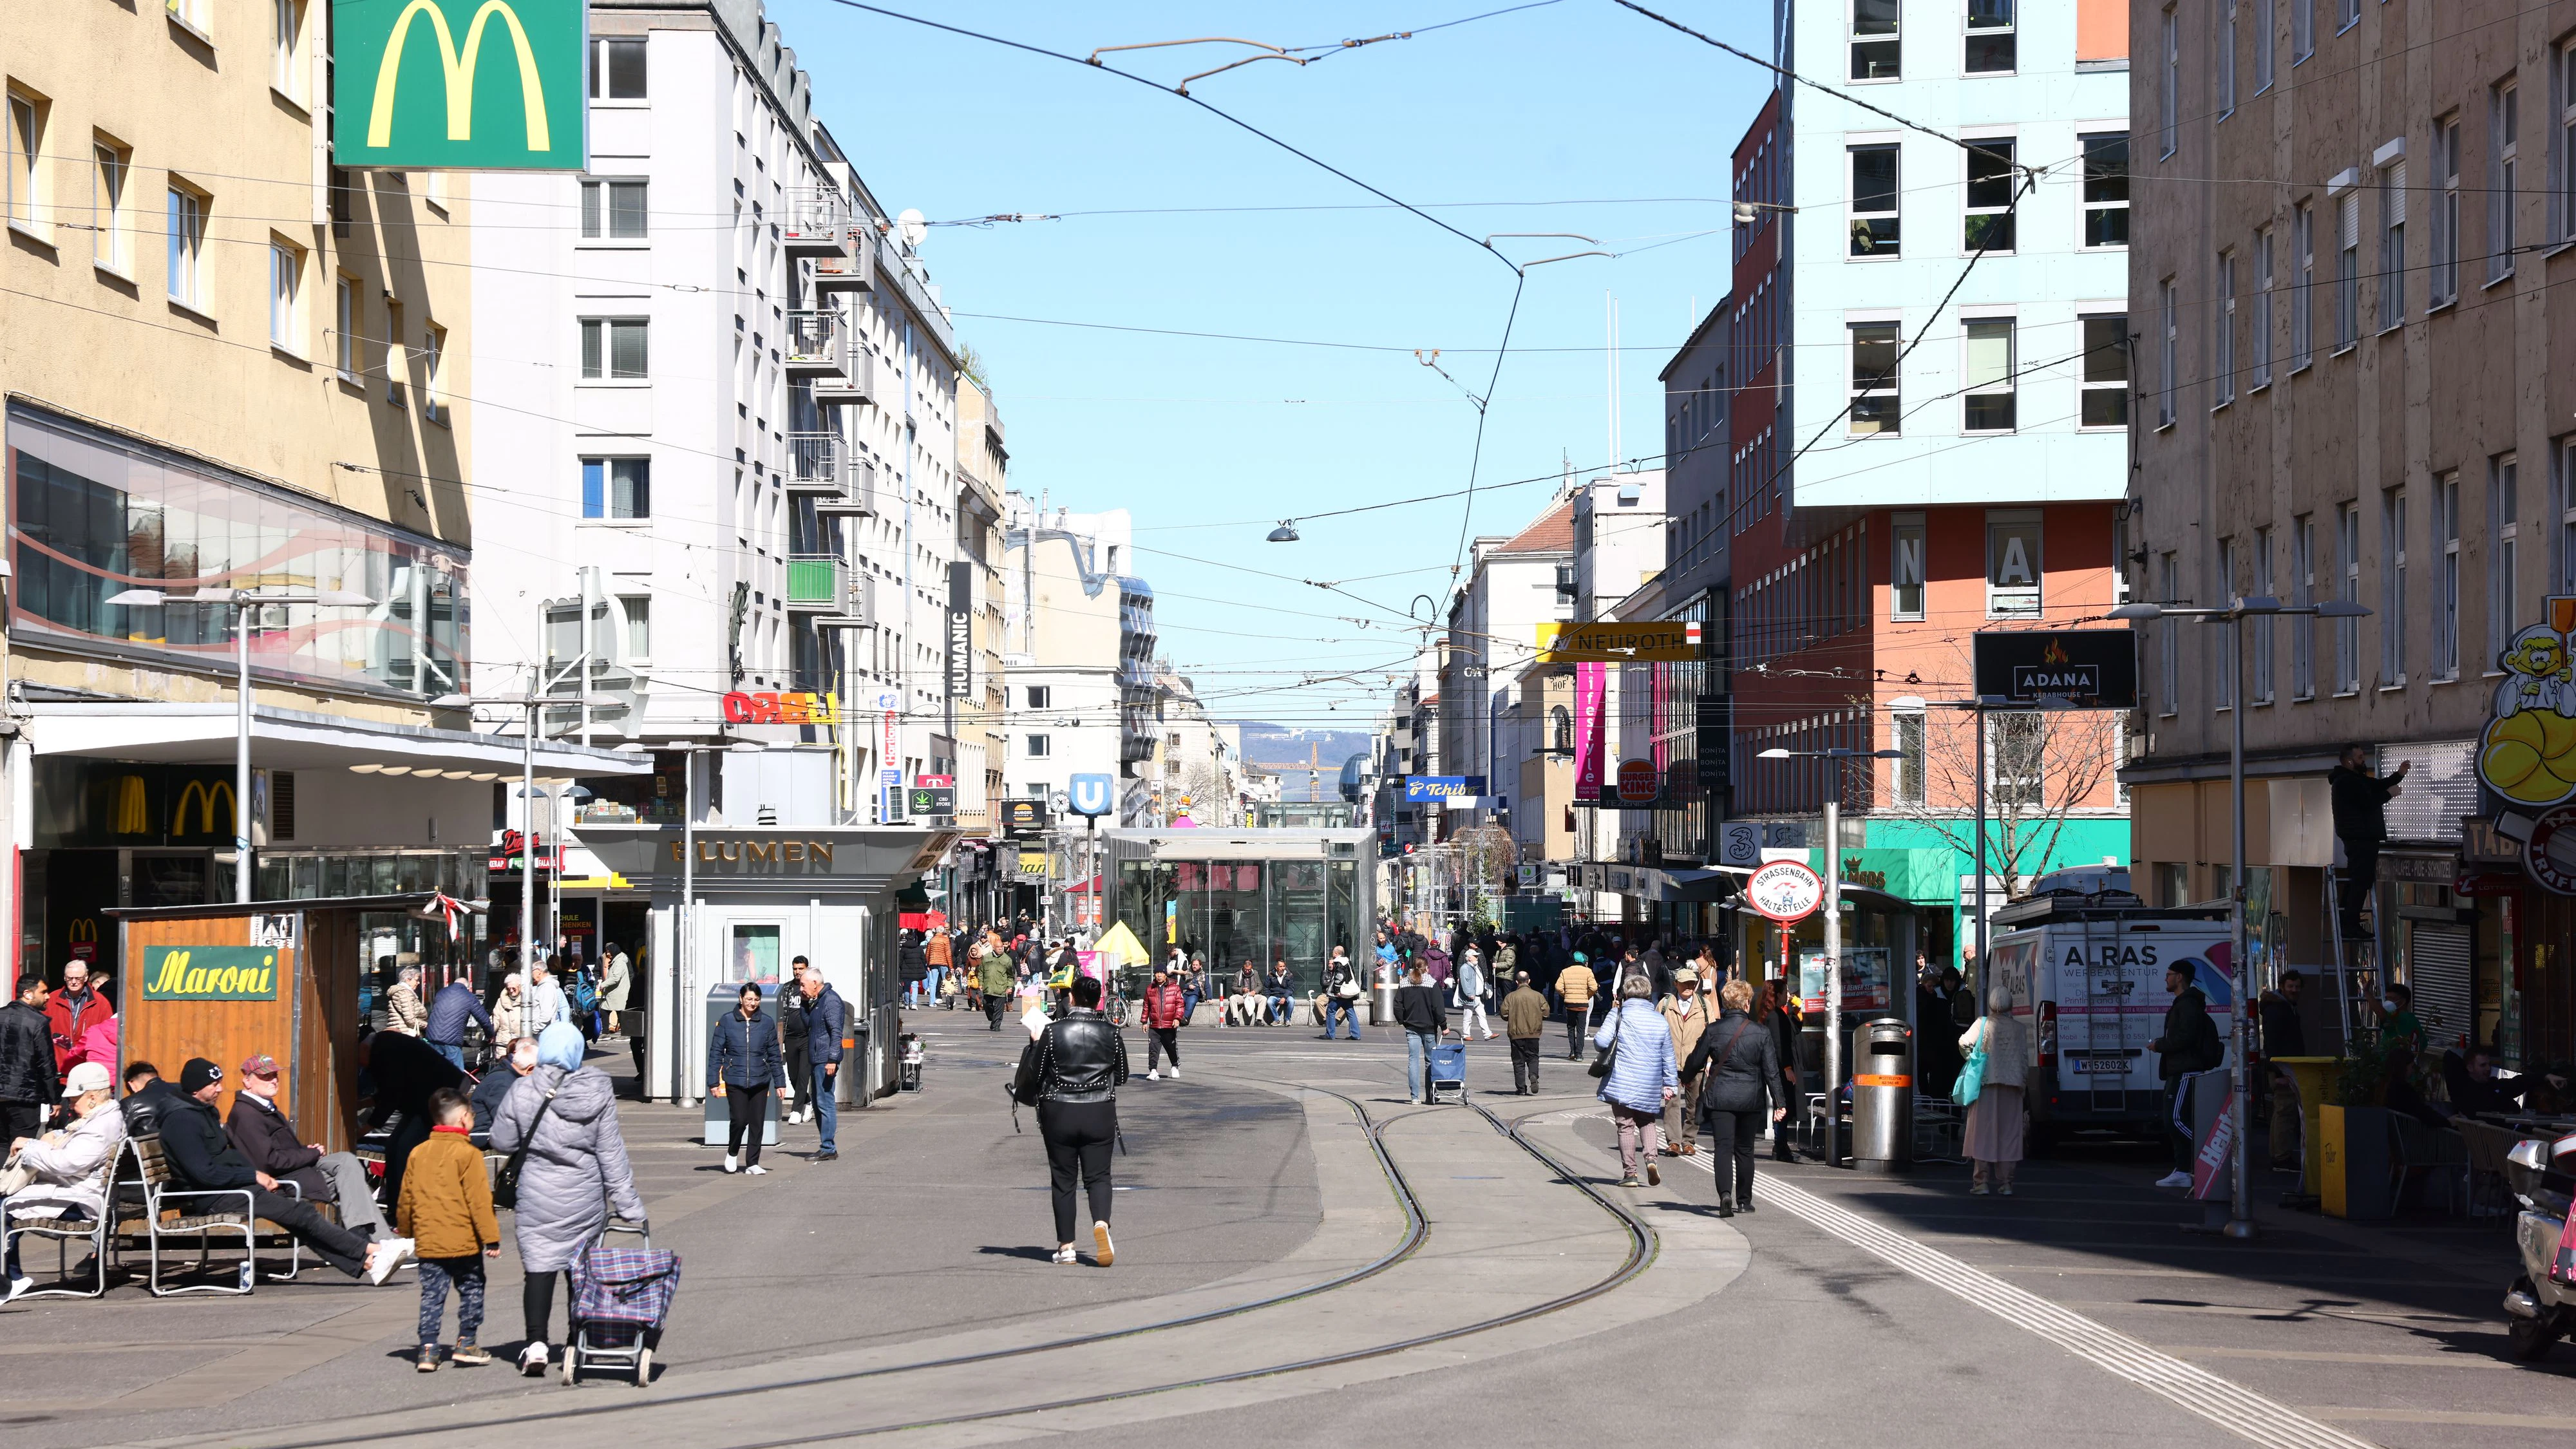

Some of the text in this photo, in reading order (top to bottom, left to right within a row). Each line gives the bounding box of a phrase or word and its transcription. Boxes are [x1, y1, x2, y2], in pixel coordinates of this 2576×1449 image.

[1579, 634, 1684, 650] NEUROTH
[952, 612, 968, 693] HUMANIC
[1553, 680, 1567, 691] HOF
[2023, 674, 2091, 687] ADANA
[1620, 773, 1656, 781] BURGER
[1426, 783, 1477, 796] Tchibo
[1620, 781, 1656, 793] KING
[1077, 782, 1104, 810] U
[1757, 867, 1815, 888] STRASSENBAHN
[1759, 896, 1812, 913] HALTESTELLE
[2065, 946, 2157, 966] ALRAS
[148, 951, 274, 994] Maroni
